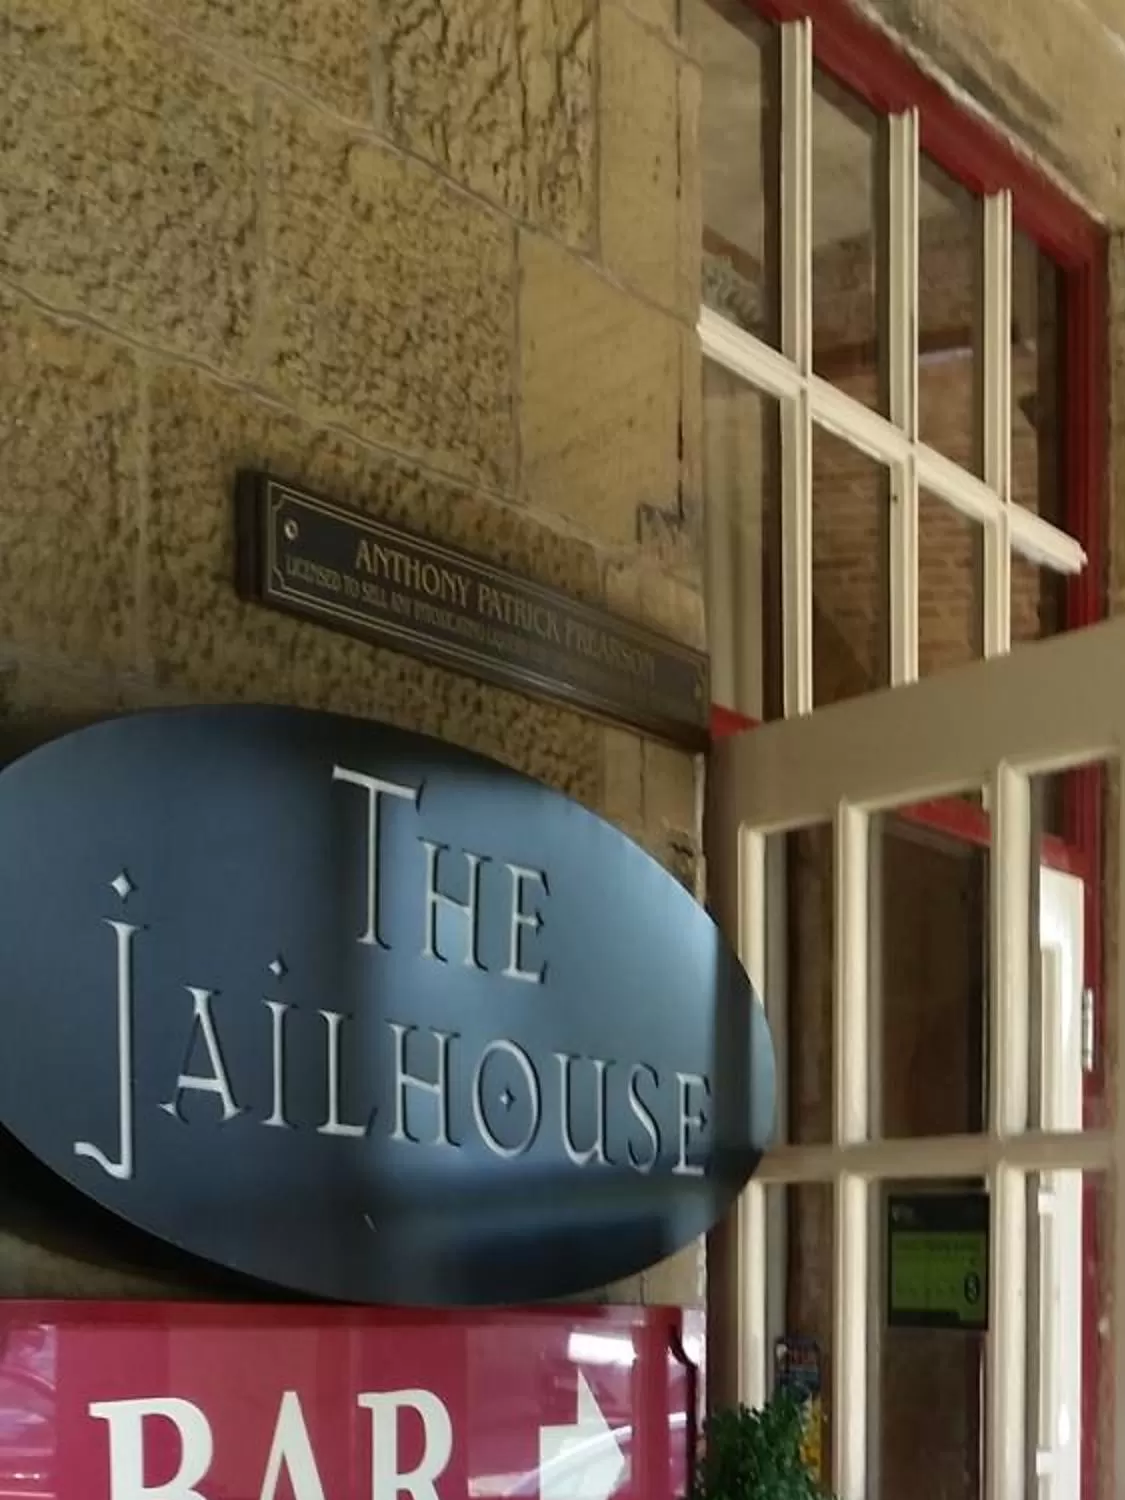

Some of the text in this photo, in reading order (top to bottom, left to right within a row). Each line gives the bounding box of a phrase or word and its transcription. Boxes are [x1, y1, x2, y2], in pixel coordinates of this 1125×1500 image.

[355, 539, 472, 609] ANTHONY
[477, 582, 561, 645] PATRICK
[332, 764, 551, 985] THE
